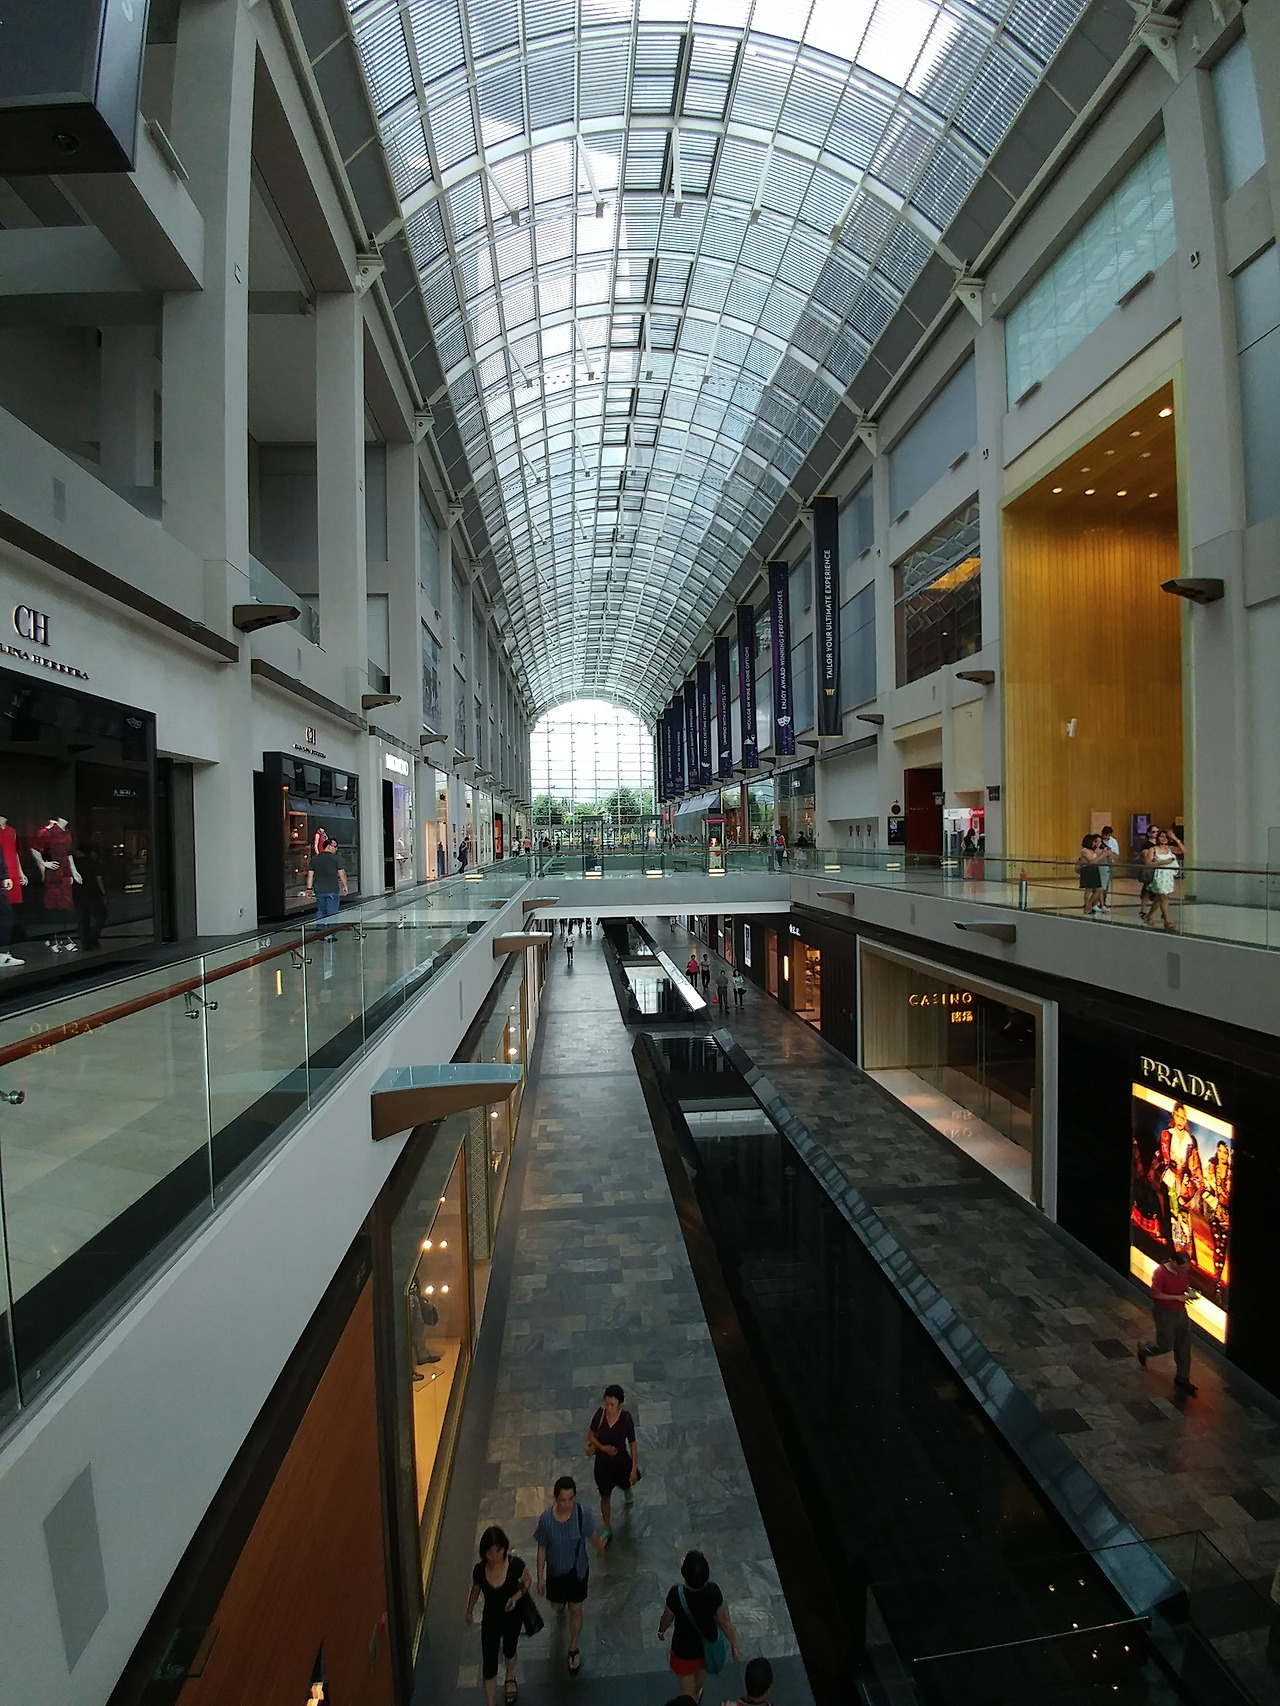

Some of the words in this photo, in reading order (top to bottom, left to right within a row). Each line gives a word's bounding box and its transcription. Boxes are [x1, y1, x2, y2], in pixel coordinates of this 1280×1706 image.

[824, 550, 832, 594] EXPERIENCE
[12, 604, 51, 647] CH
[824, 596, 832, 630] ULTIMATE
[32, 654, 90, 680] HERRERA
[778, 638, 786, 689] AWARD-WINNING
[908, 992, 973, 1006] CASINO
[1140, 1056, 1223, 1107] PRADA
